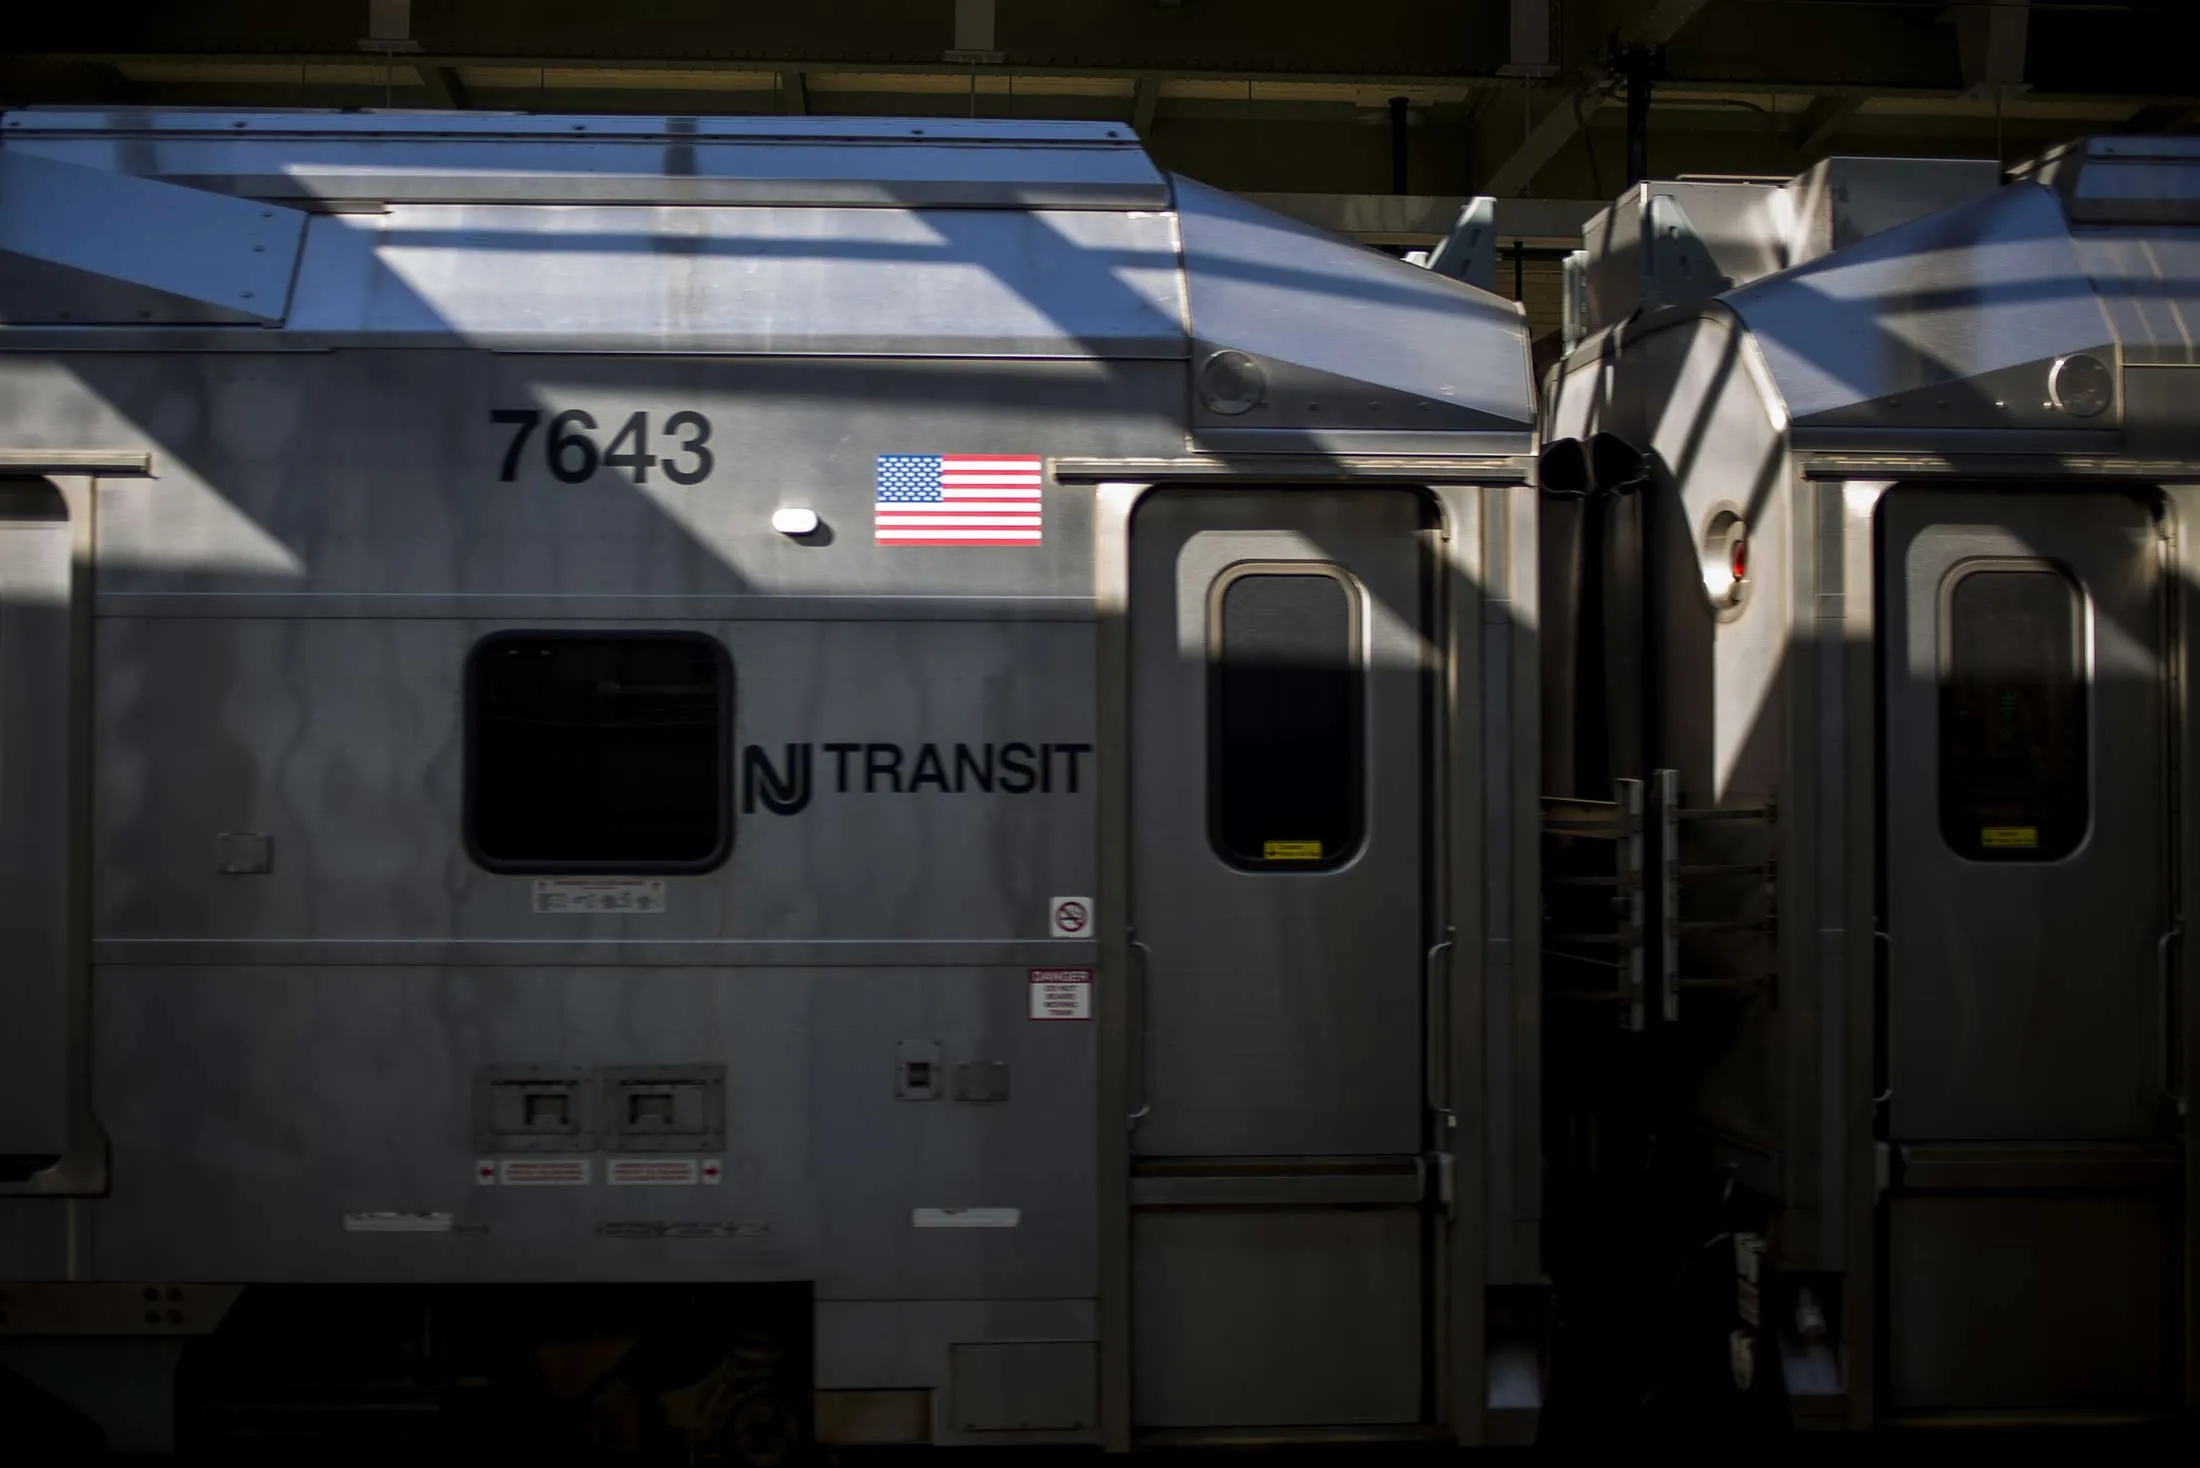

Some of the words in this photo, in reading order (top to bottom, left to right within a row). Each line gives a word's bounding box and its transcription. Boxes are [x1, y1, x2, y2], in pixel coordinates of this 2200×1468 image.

[490, 409, 714, 485] 7643
[743, 743, 812, 816] NJ
[823, 743, 1092, 793] TRANSIT
